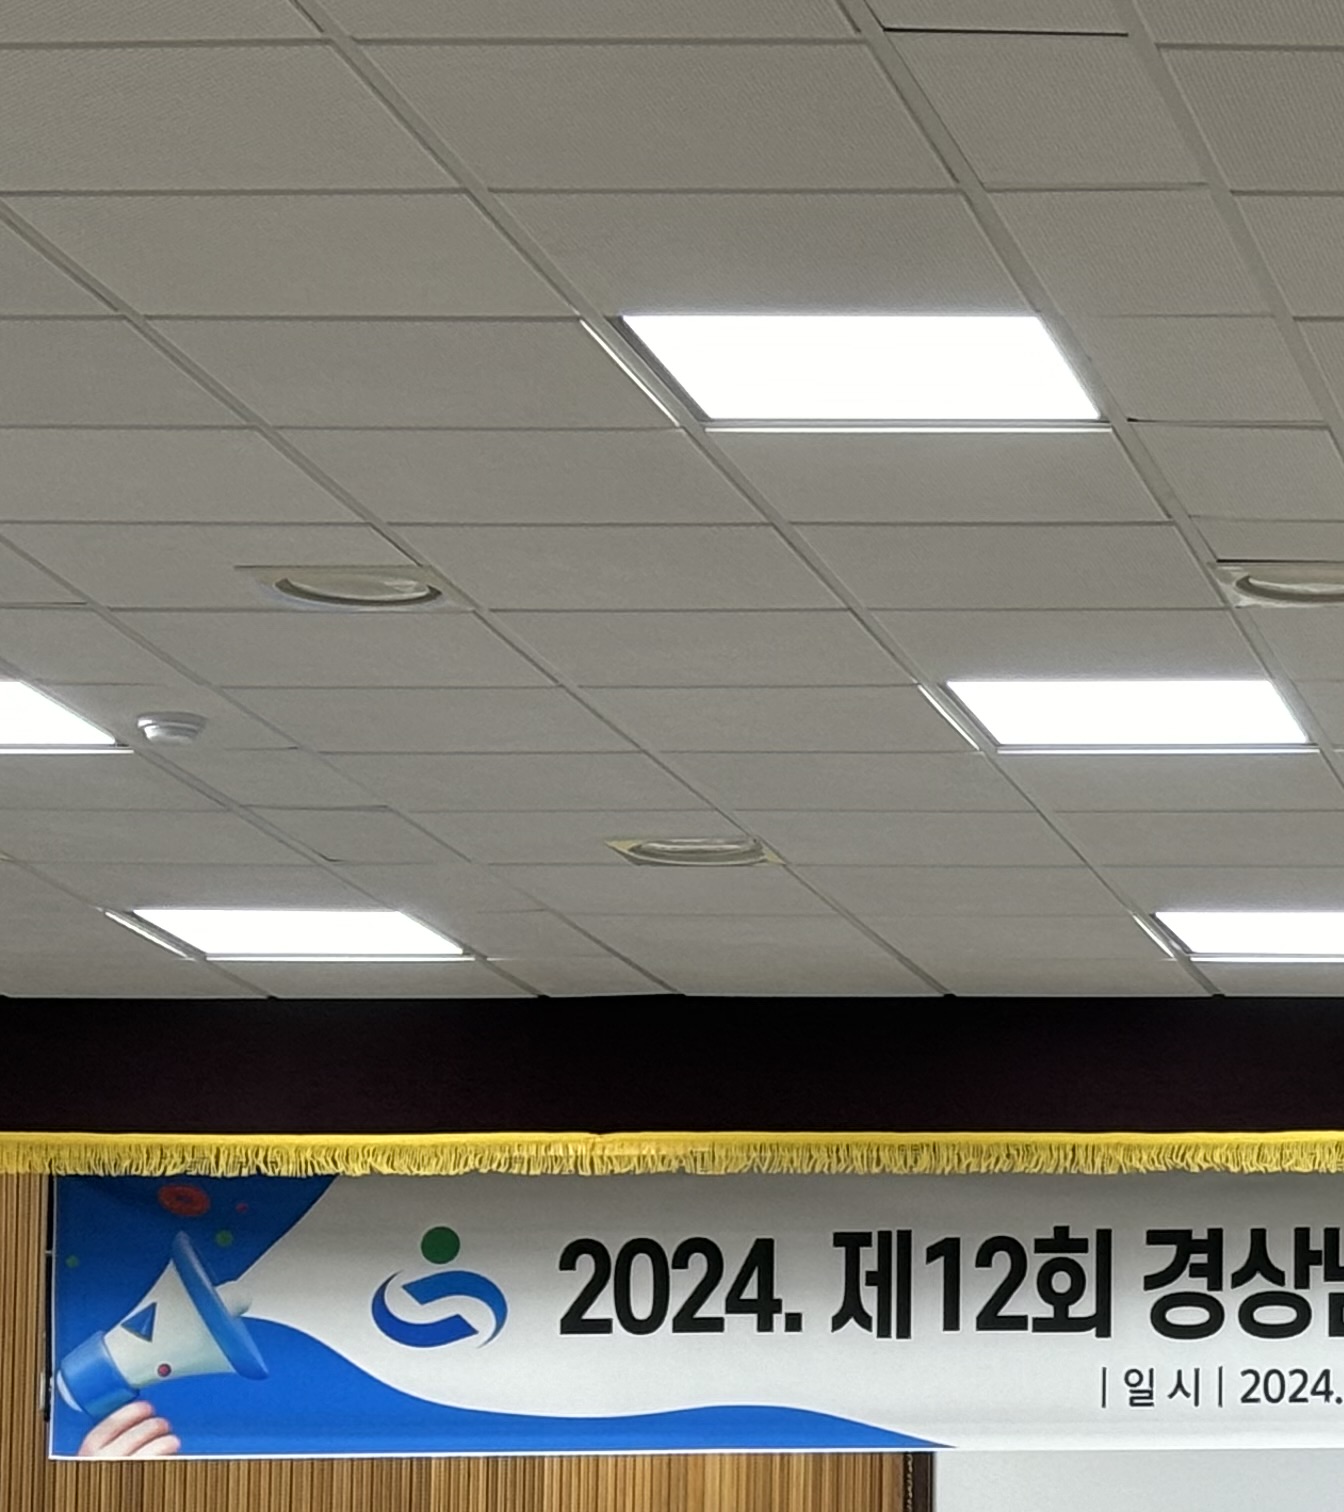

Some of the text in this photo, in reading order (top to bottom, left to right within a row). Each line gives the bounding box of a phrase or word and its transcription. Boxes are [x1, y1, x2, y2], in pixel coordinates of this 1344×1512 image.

[559, 1237, 803, 1335] 2024.
[831, 1226, 1112, 1339] 제12회
[1240, 1367, 1344, 1406] 2024.
